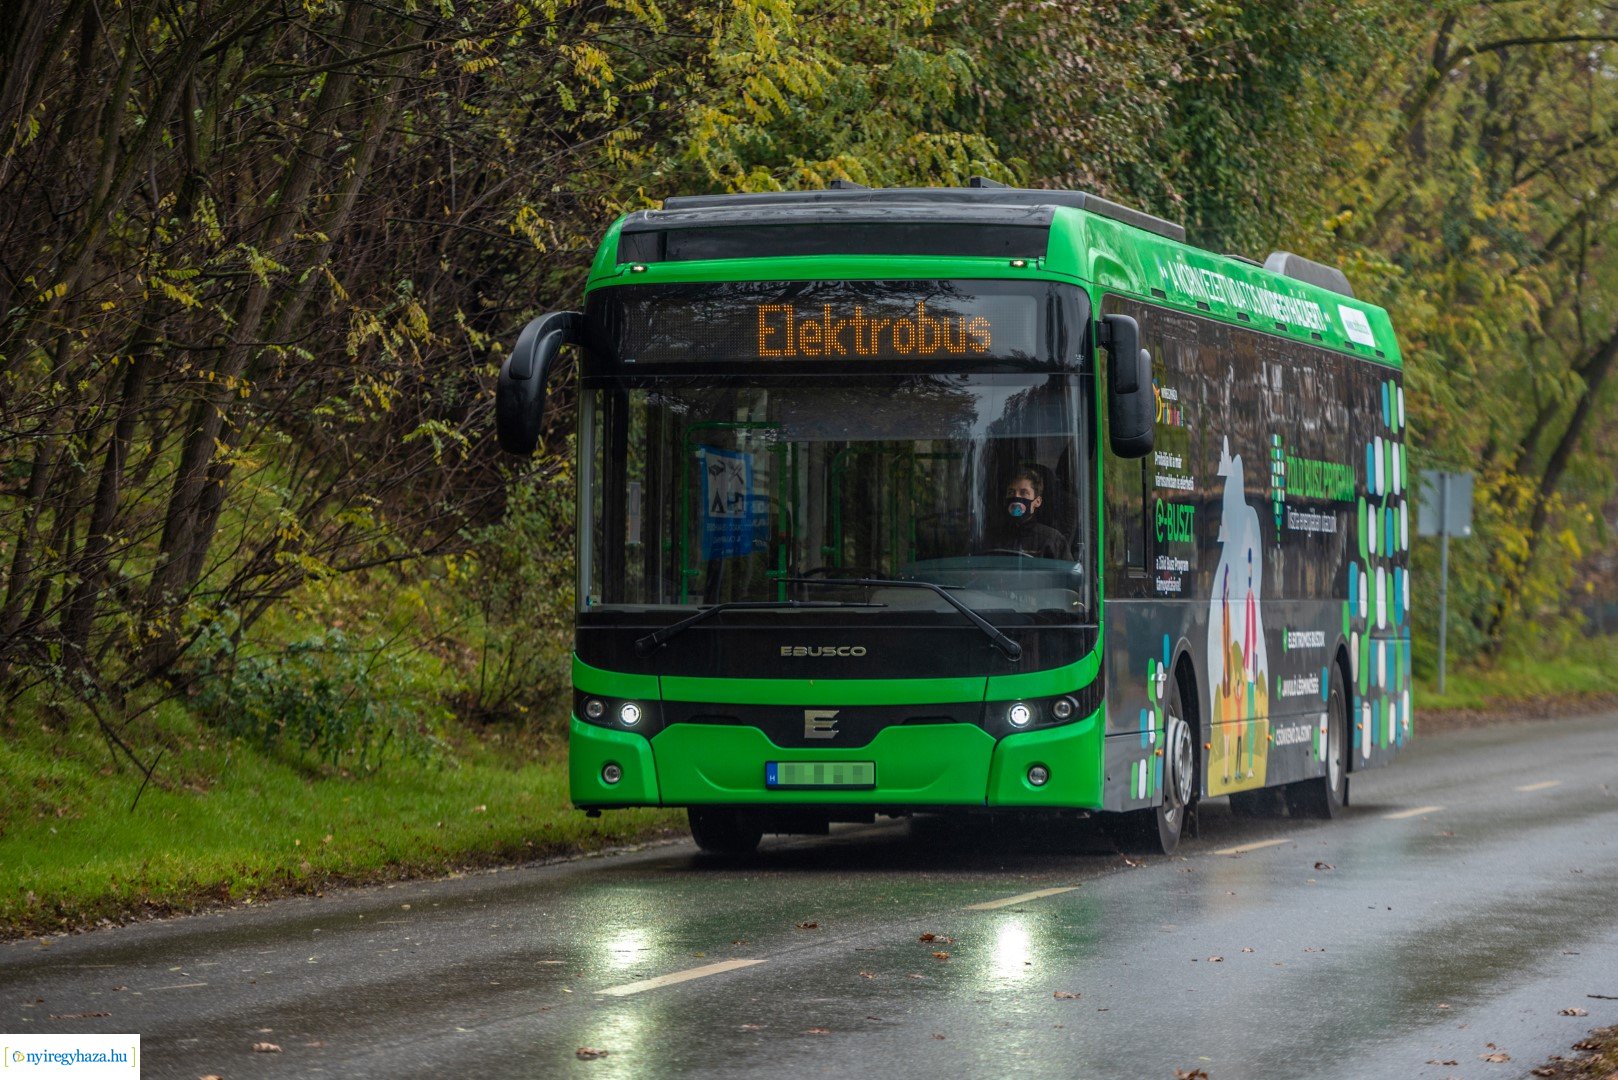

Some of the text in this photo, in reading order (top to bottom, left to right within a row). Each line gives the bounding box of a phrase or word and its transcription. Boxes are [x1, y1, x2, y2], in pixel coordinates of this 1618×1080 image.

[758, 302, 991, 356] Elektrobus
[1304, 458, 1323, 499] BUSZ
[1323, 461, 1355, 502] PROGRAM
[1156, 498, 1195, 542] e-BUSZT
[781, 646, 867, 657] EBUSCO
